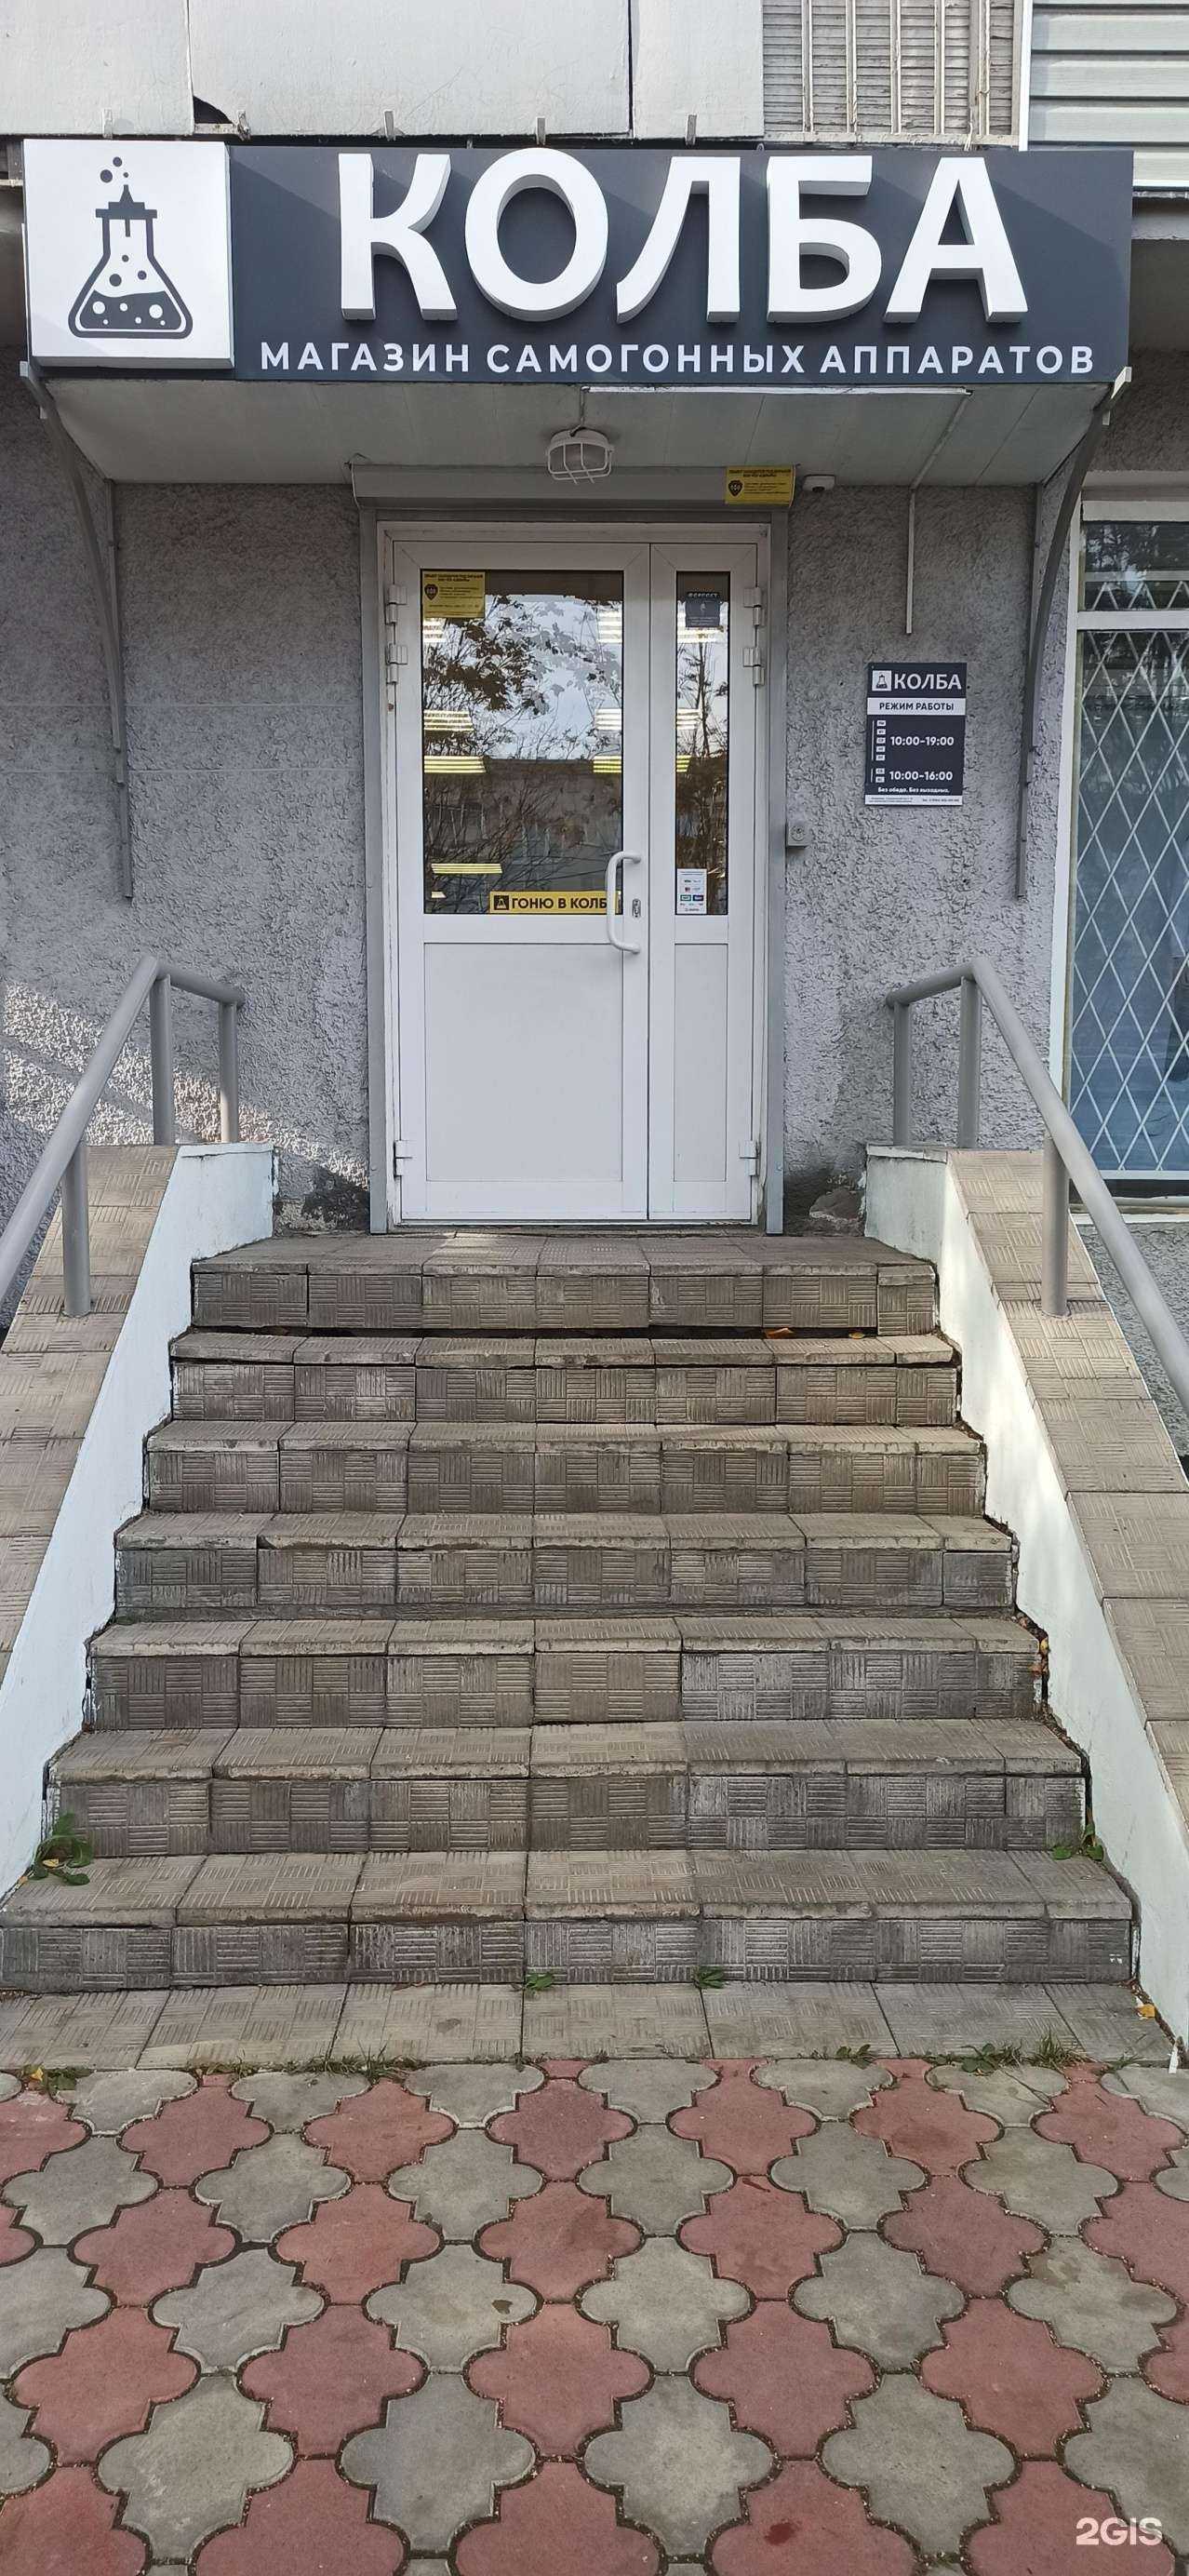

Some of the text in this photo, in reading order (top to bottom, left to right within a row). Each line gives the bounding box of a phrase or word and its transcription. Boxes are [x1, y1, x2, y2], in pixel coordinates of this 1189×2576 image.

[338, 147, 1028, 323] КОЛБА
[261, 341, 1095, 374] МАГАЗИН САМОГОННЫХ АППАРАТОВ
[894, 674, 961, 690] КОЛБА
[512, 898, 608, 908] ГОНЮ В КОЛБ
